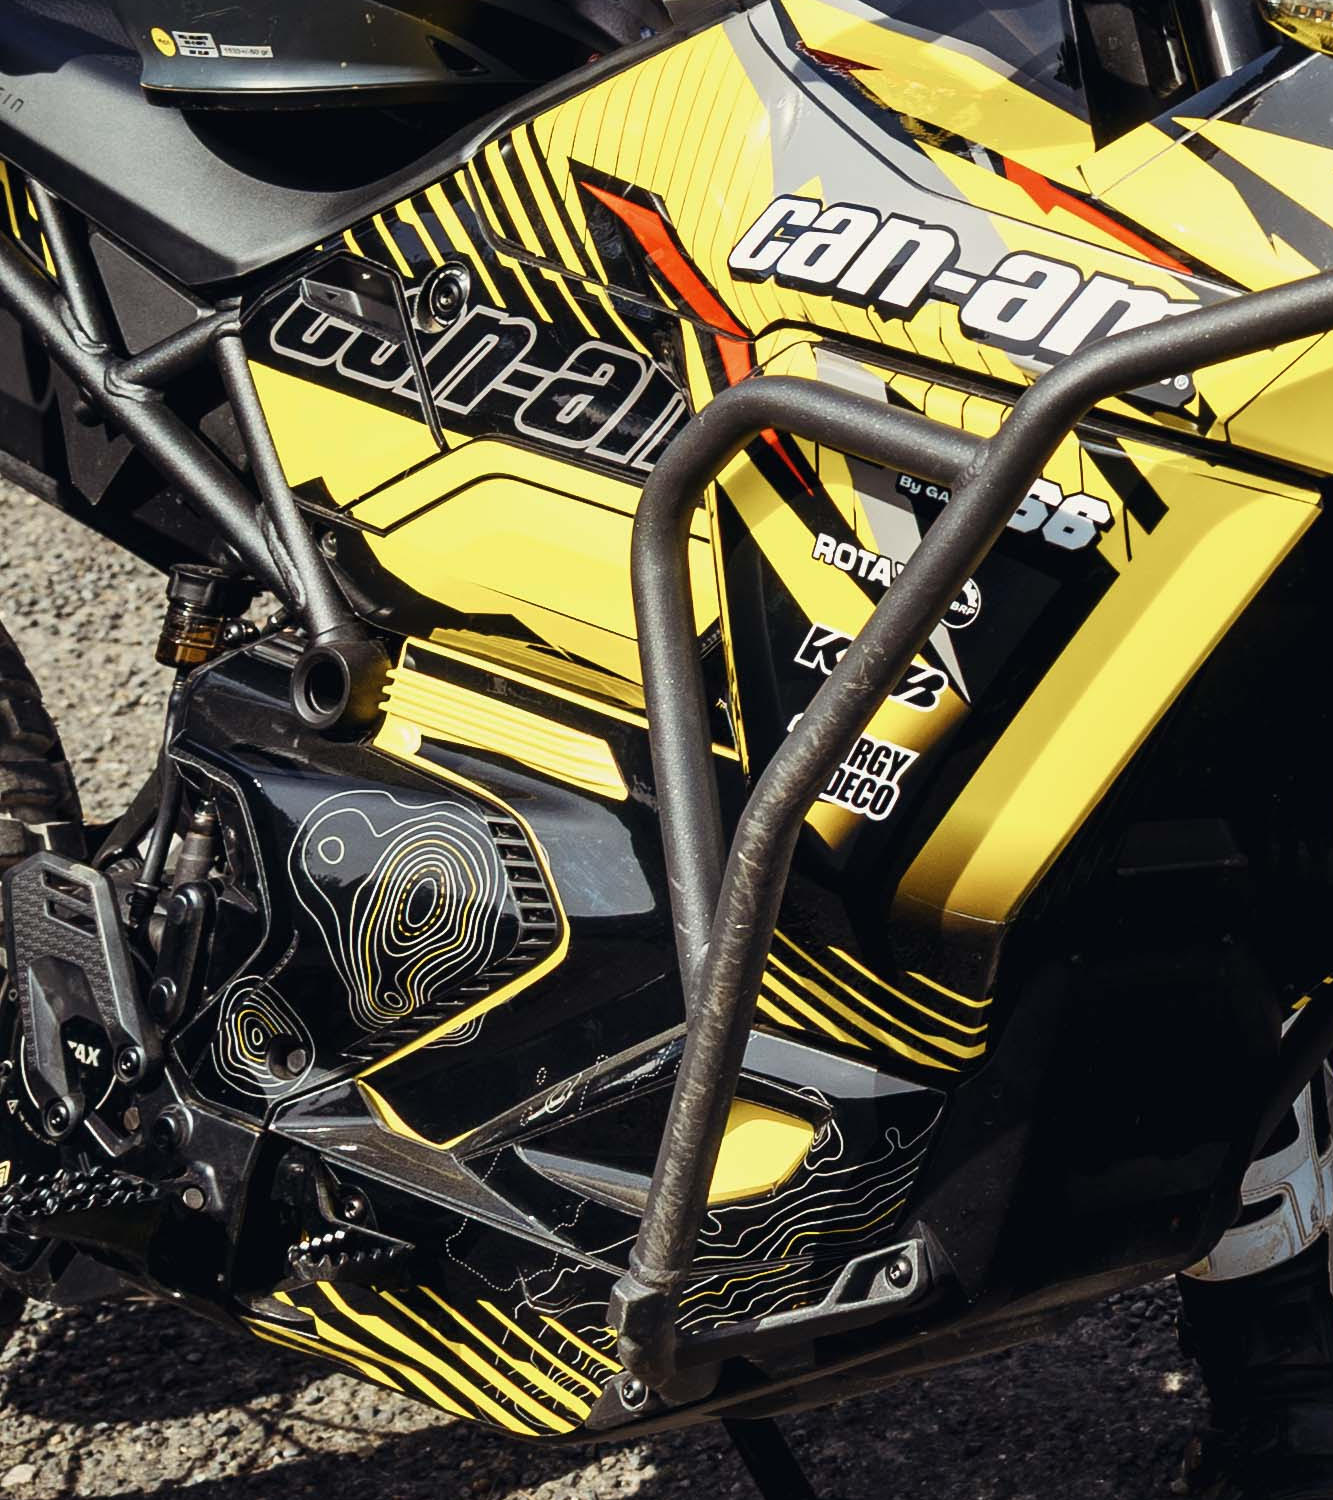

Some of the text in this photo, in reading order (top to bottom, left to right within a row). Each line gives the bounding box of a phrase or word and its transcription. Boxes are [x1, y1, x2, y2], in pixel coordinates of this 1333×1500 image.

[898, 473, 951, 504] By GA
[950, 600, 976, 617] BRP
[793, 623, 949, 713] KB
